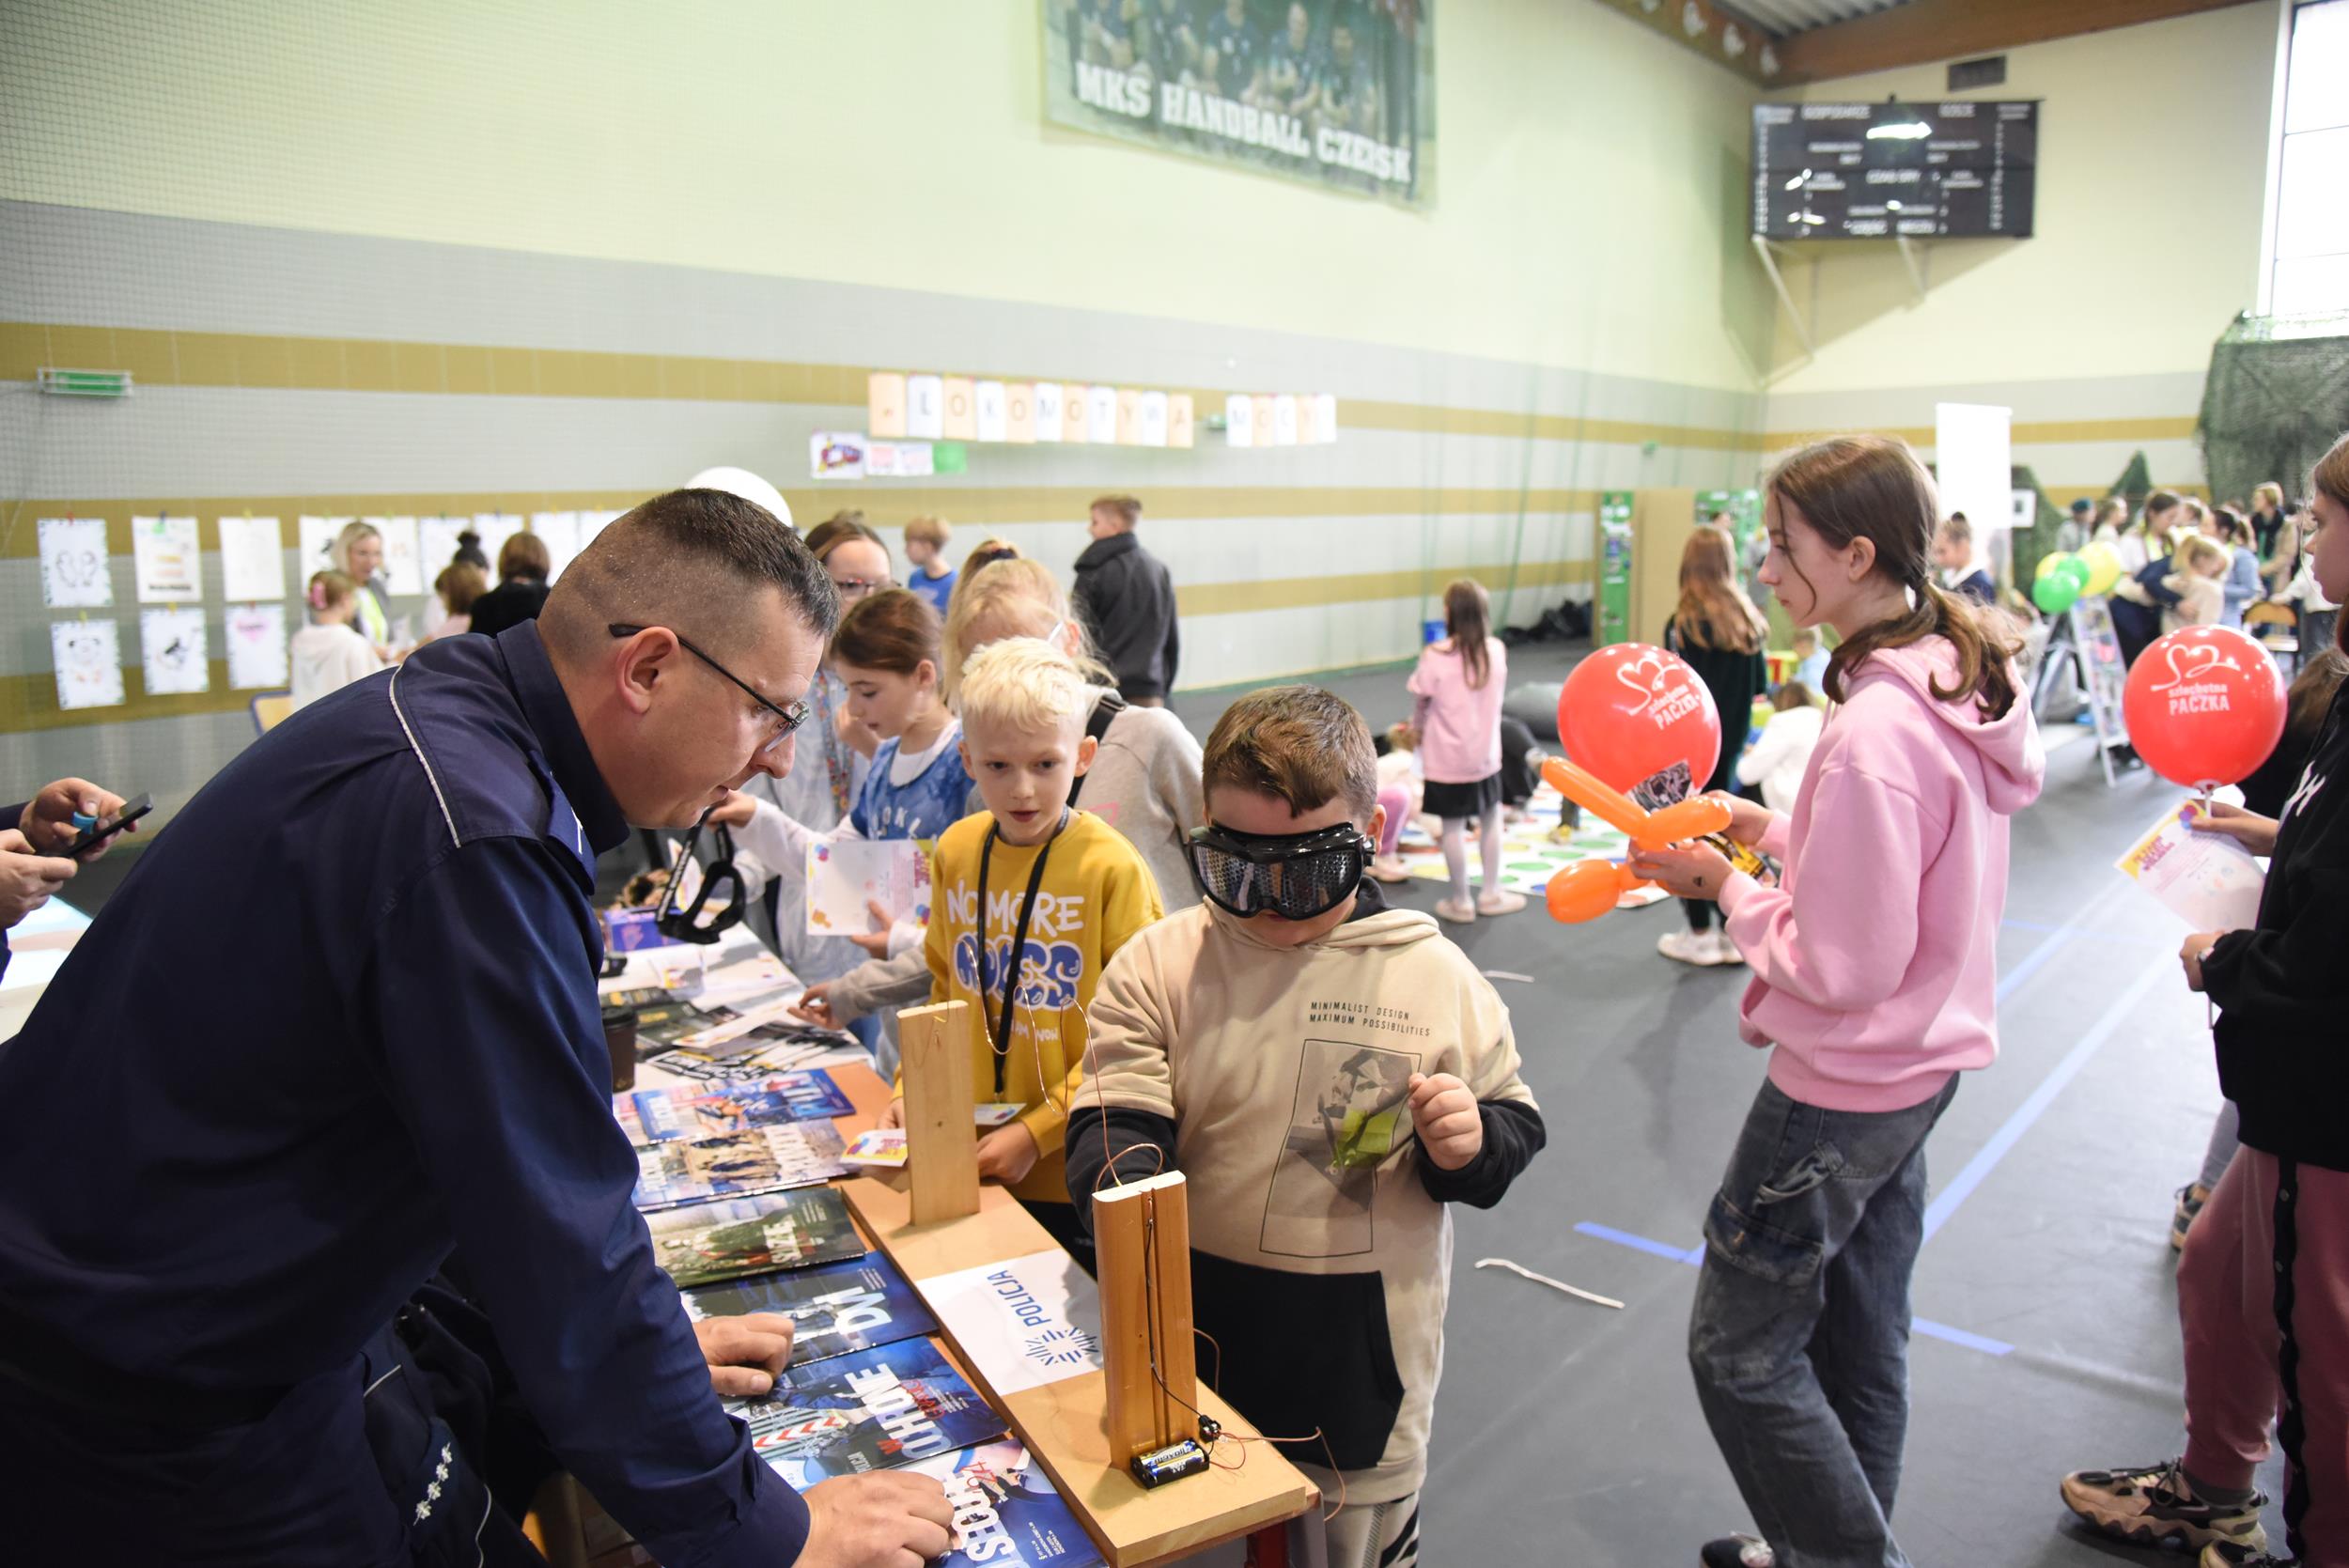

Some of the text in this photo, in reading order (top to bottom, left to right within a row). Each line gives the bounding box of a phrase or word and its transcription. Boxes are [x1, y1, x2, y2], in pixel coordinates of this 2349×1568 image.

[1075, 60, 1152, 118] MKS
[1161, 82, 1311, 158] HANDBALL
[1654, 693, 1700, 731] PACZKA
[2169, 693, 2231, 716] PACZKA
[946, 879, 1084, 938] NO MORE
[1309, 1014, 1431, 1037] MAXIMUM POSSIBILITIES
[1311, 1001, 1410, 1020] MINIMALIST DESIGN
[987, 1269, 1052, 1327] POLICJA
[844, 1362, 952, 1460] OCHRONIE
[876, 1438, 904, 1455] W
